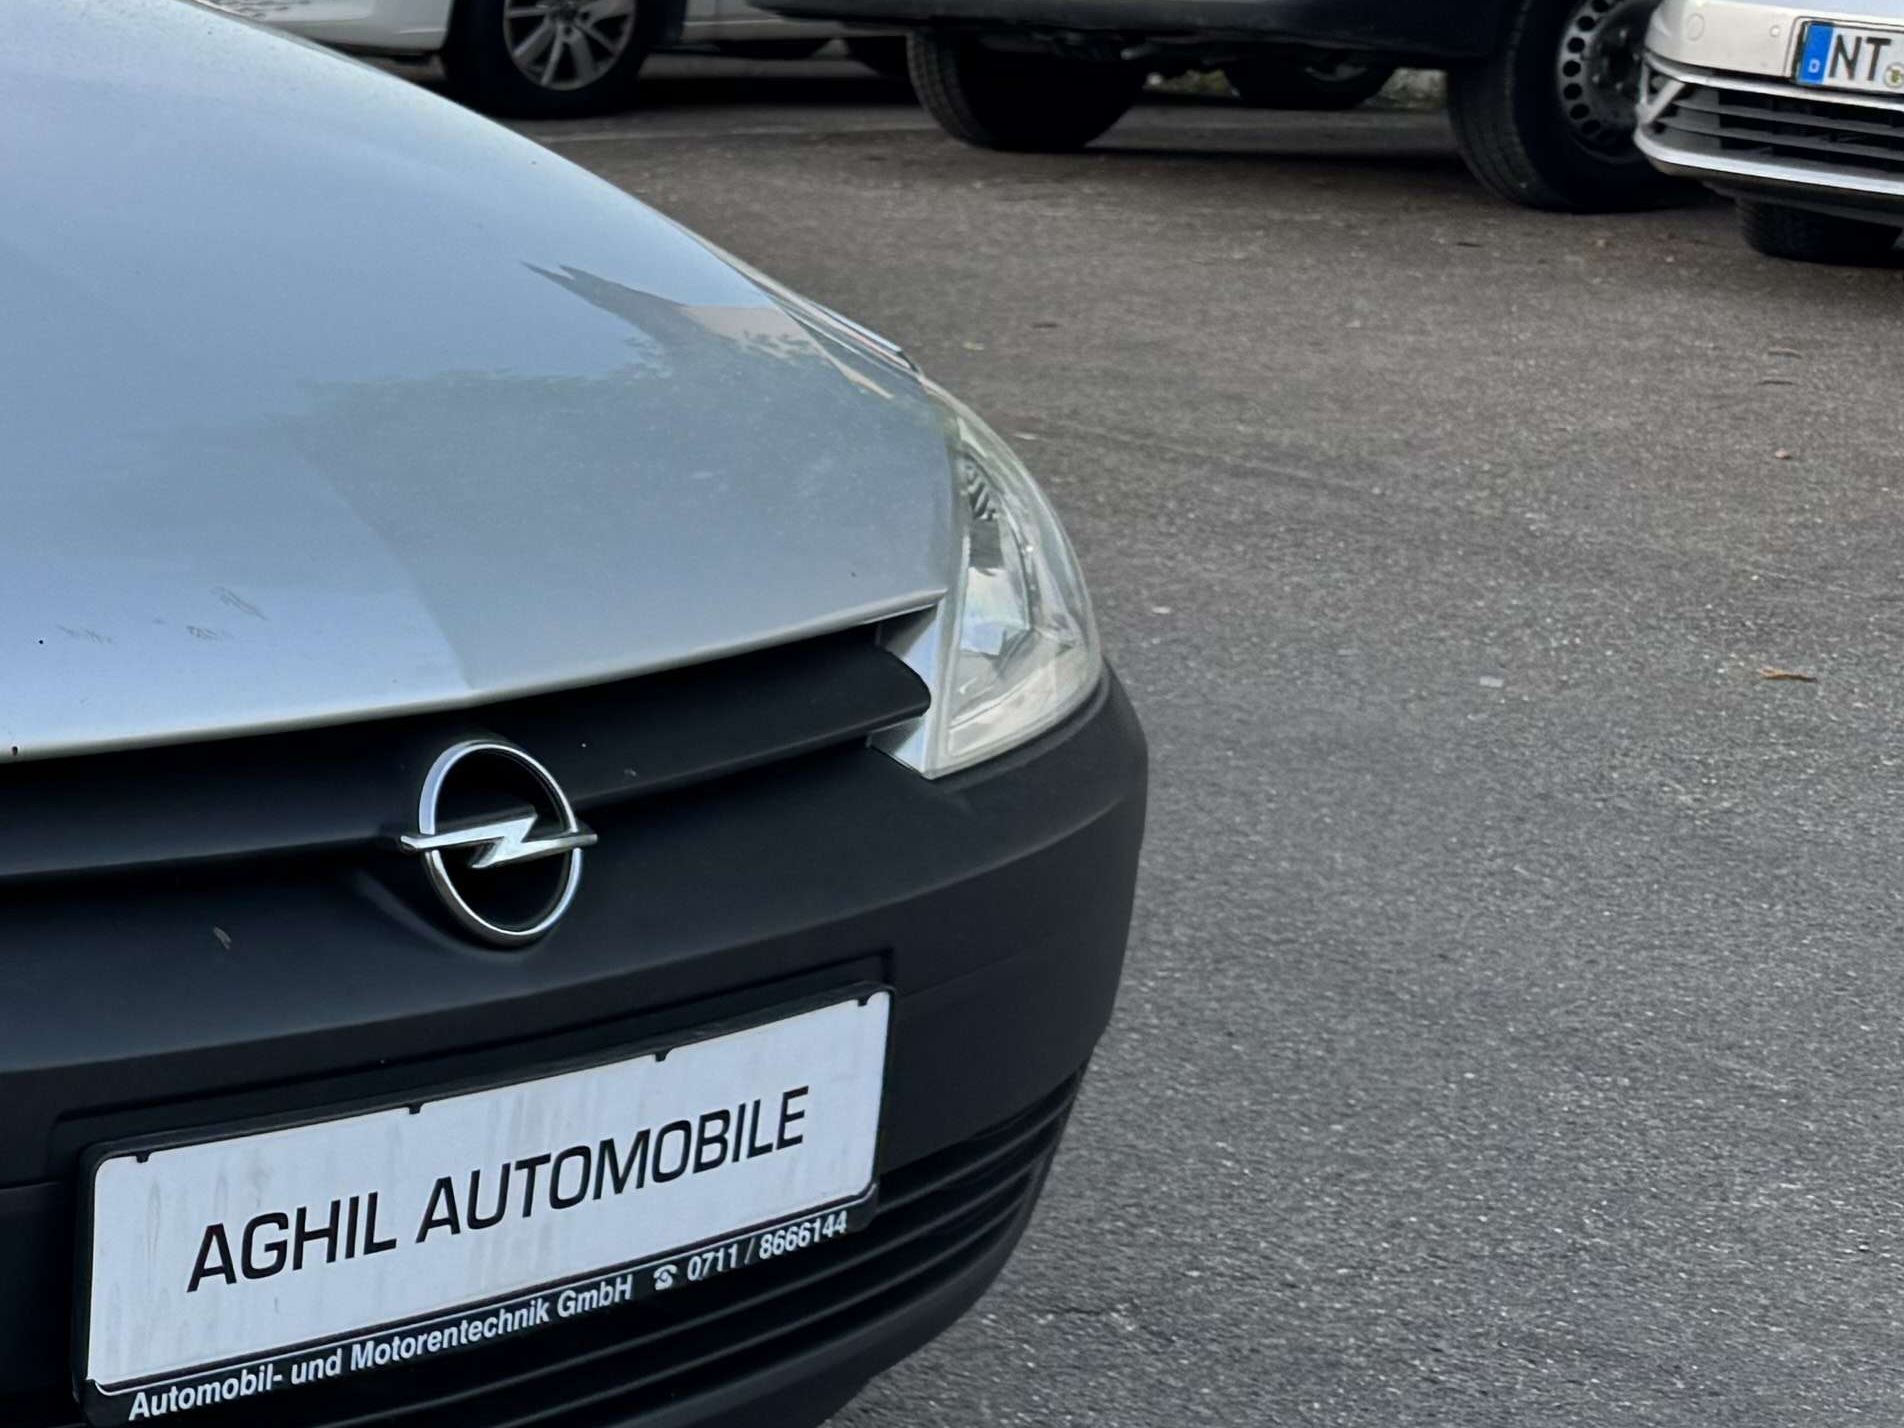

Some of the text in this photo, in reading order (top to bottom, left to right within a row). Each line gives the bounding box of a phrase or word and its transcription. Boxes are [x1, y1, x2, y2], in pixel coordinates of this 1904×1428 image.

[1828, 34, 1892, 81] NT
[186, 1085, 810, 1293] AGHIL AUTOMOBILE
[128, 1363, 284, 1422] Automobil-
[290, 1349, 342, 1385] und
[349, 1299, 551, 1371] Motorentechnik
[556, 1274, 633, 1318] GmbH
[686, 1243, 740, 1281] 0711
[758, 1210, 848, 1262] 8666144
